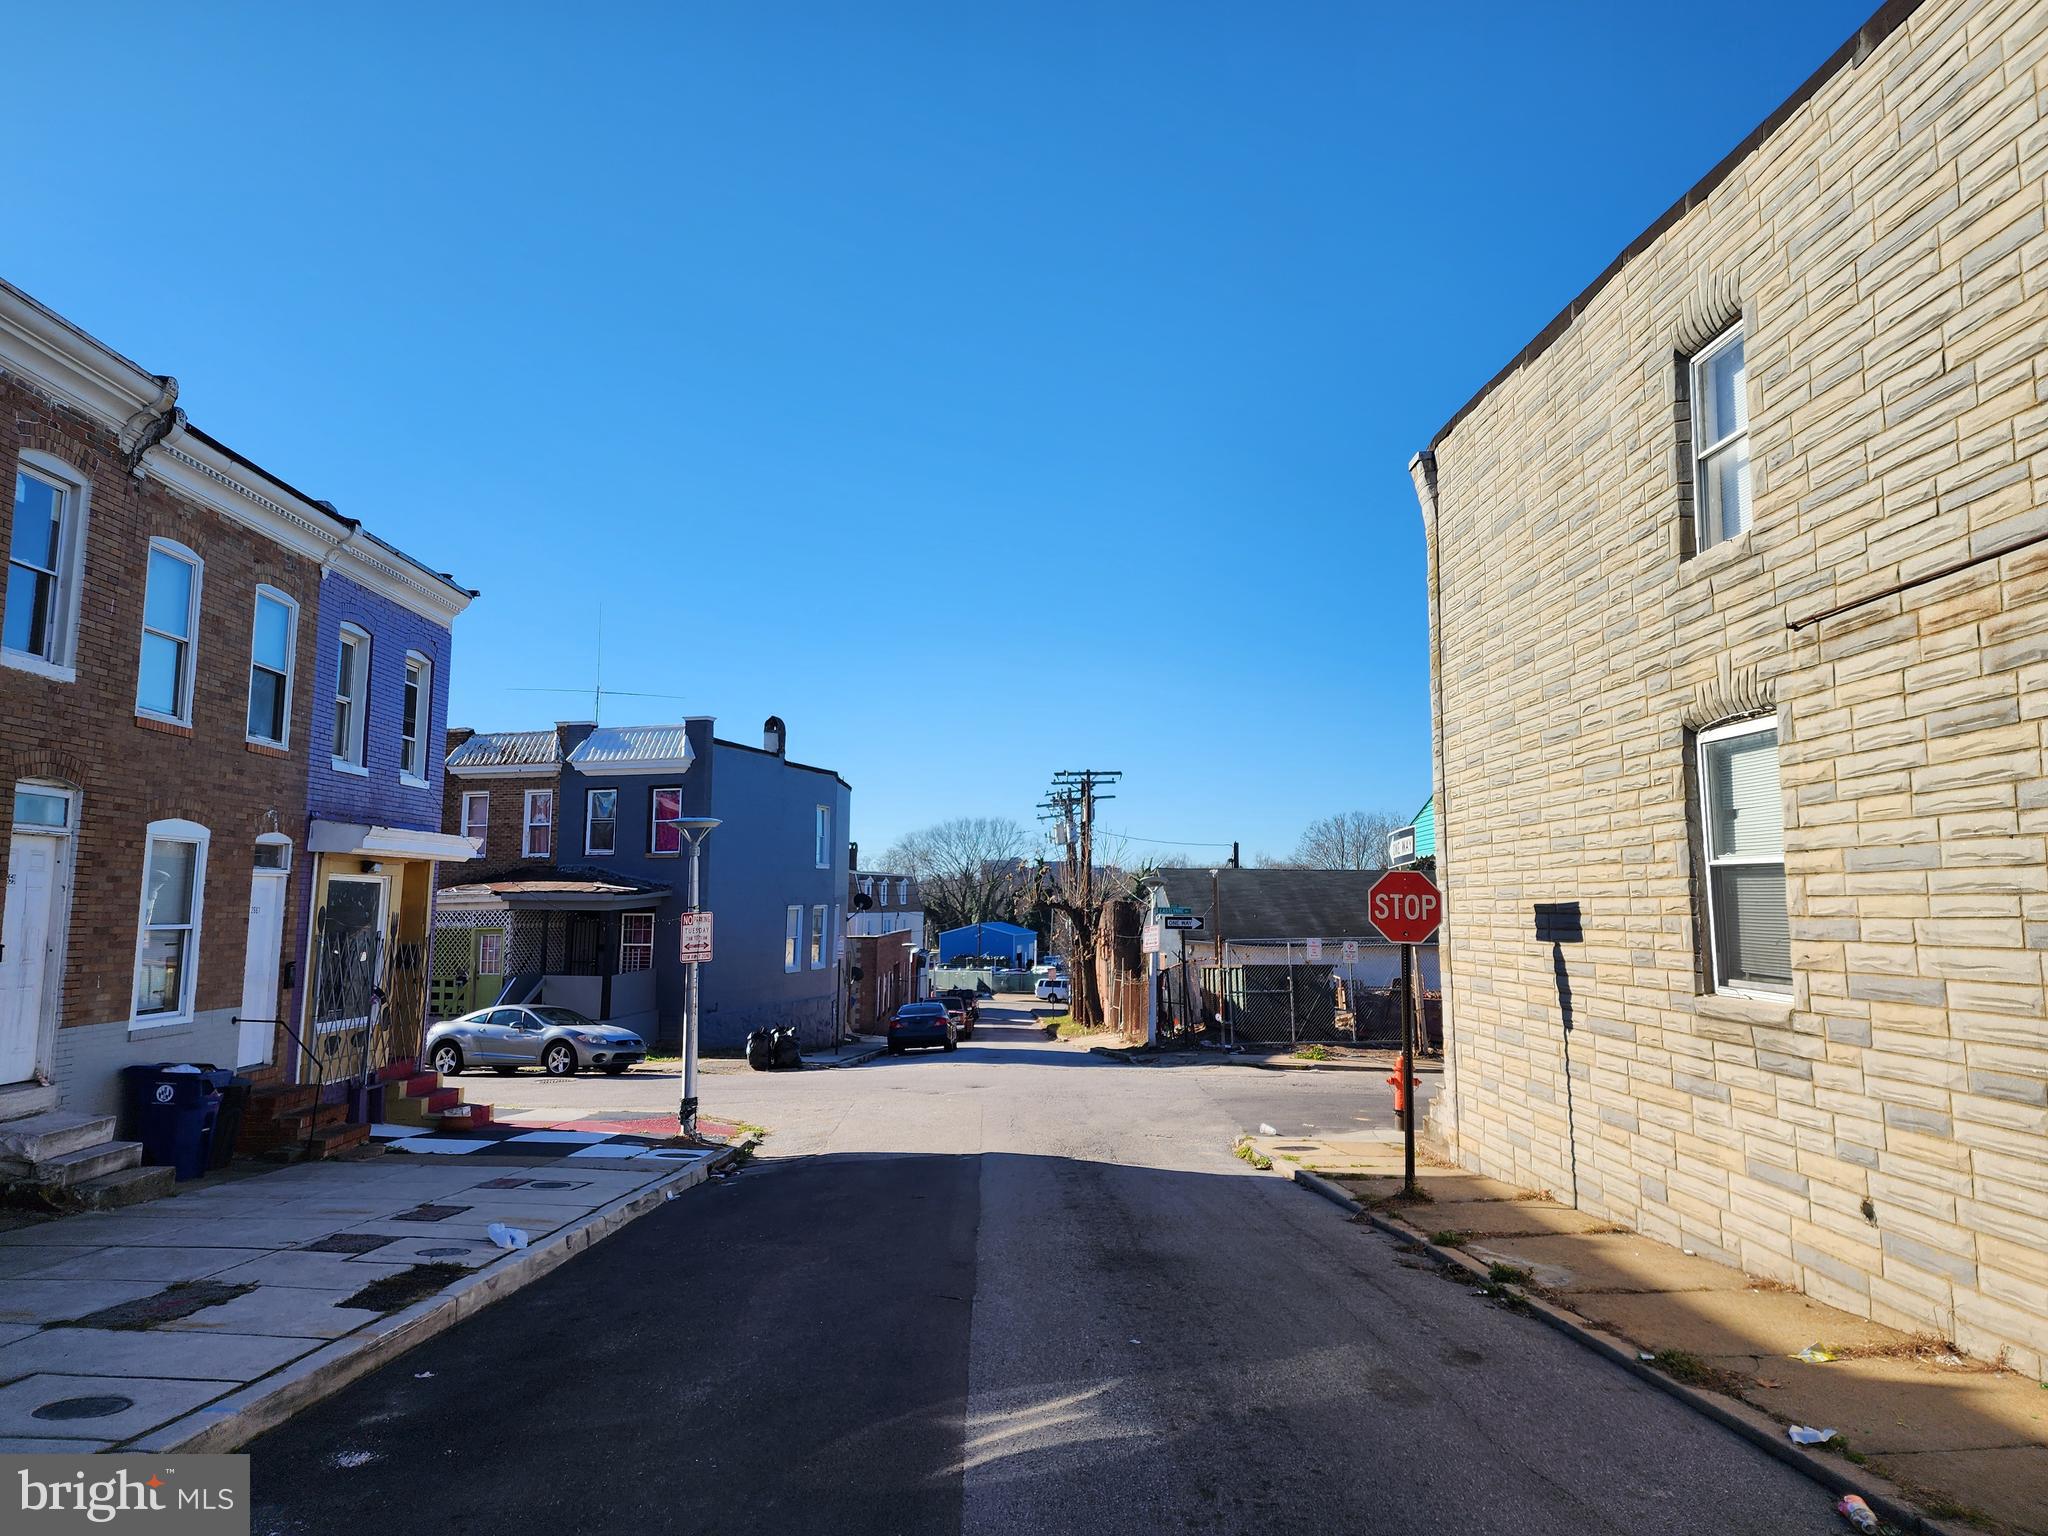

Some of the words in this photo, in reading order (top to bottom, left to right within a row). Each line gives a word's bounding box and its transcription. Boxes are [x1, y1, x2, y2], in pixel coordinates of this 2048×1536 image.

[1392, 841, 1401, 857] ONE
[1402, 838, 1413, 853] WAY
[1375, 893, 1437, 920] STOP
[683, 915, 693, 925] NO
[694, 915, 711, 923] PARKING
